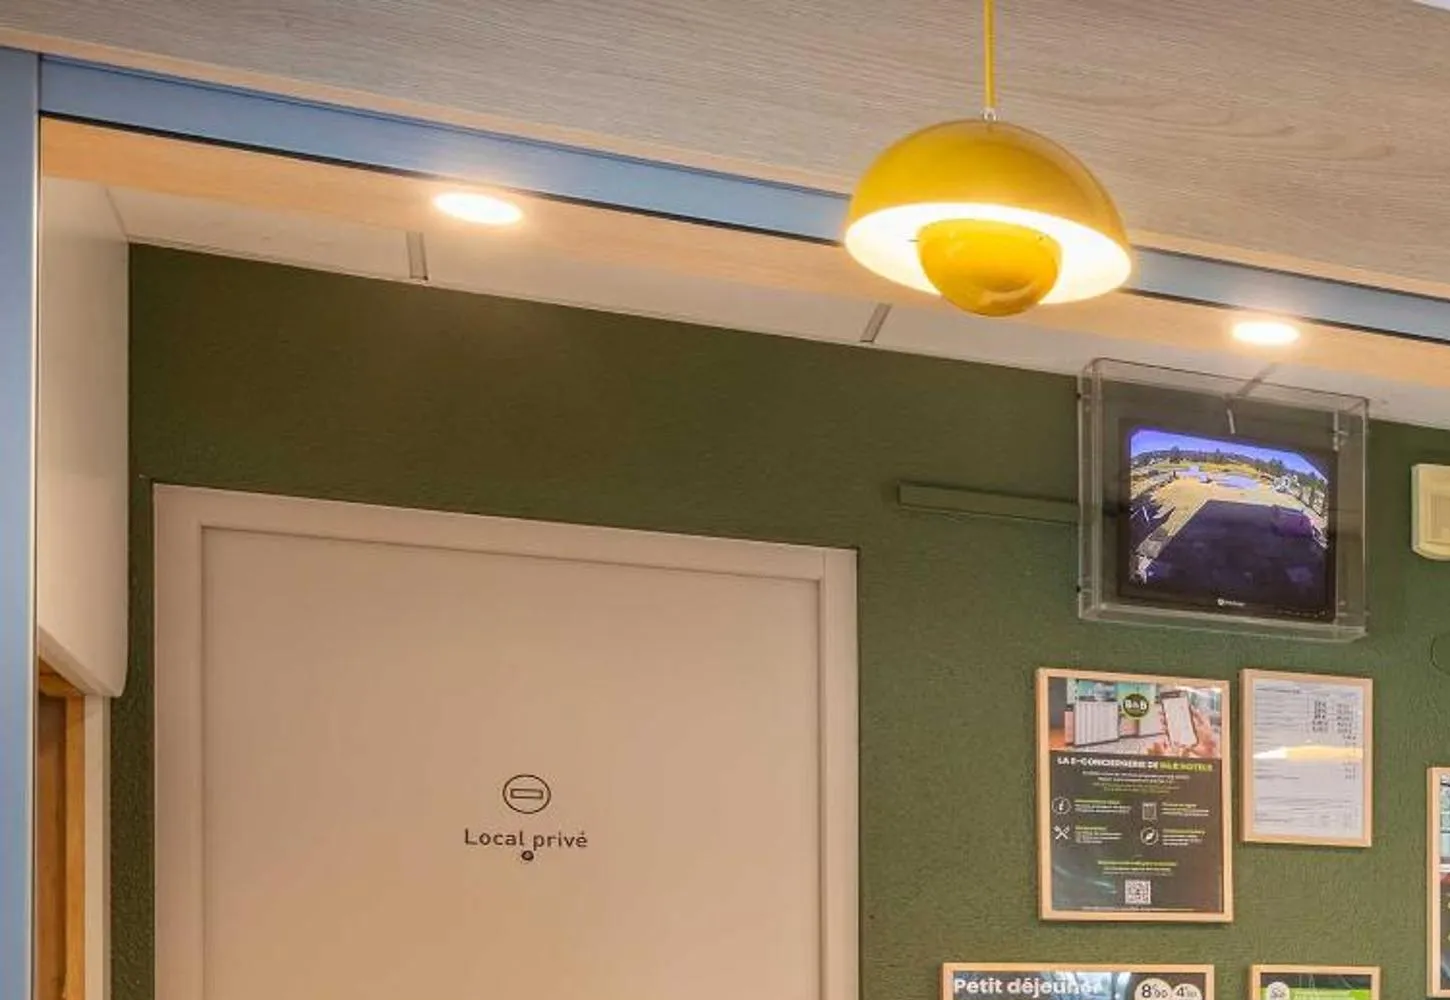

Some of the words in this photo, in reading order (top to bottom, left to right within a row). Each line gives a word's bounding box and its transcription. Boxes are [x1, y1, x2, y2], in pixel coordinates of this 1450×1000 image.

[464, 828, 525, 846] Local
[533, 829, 588, 851] privé
[954, 978, 1002, 994] Petit
[1007, 978, 1101, 998] déjeuner
